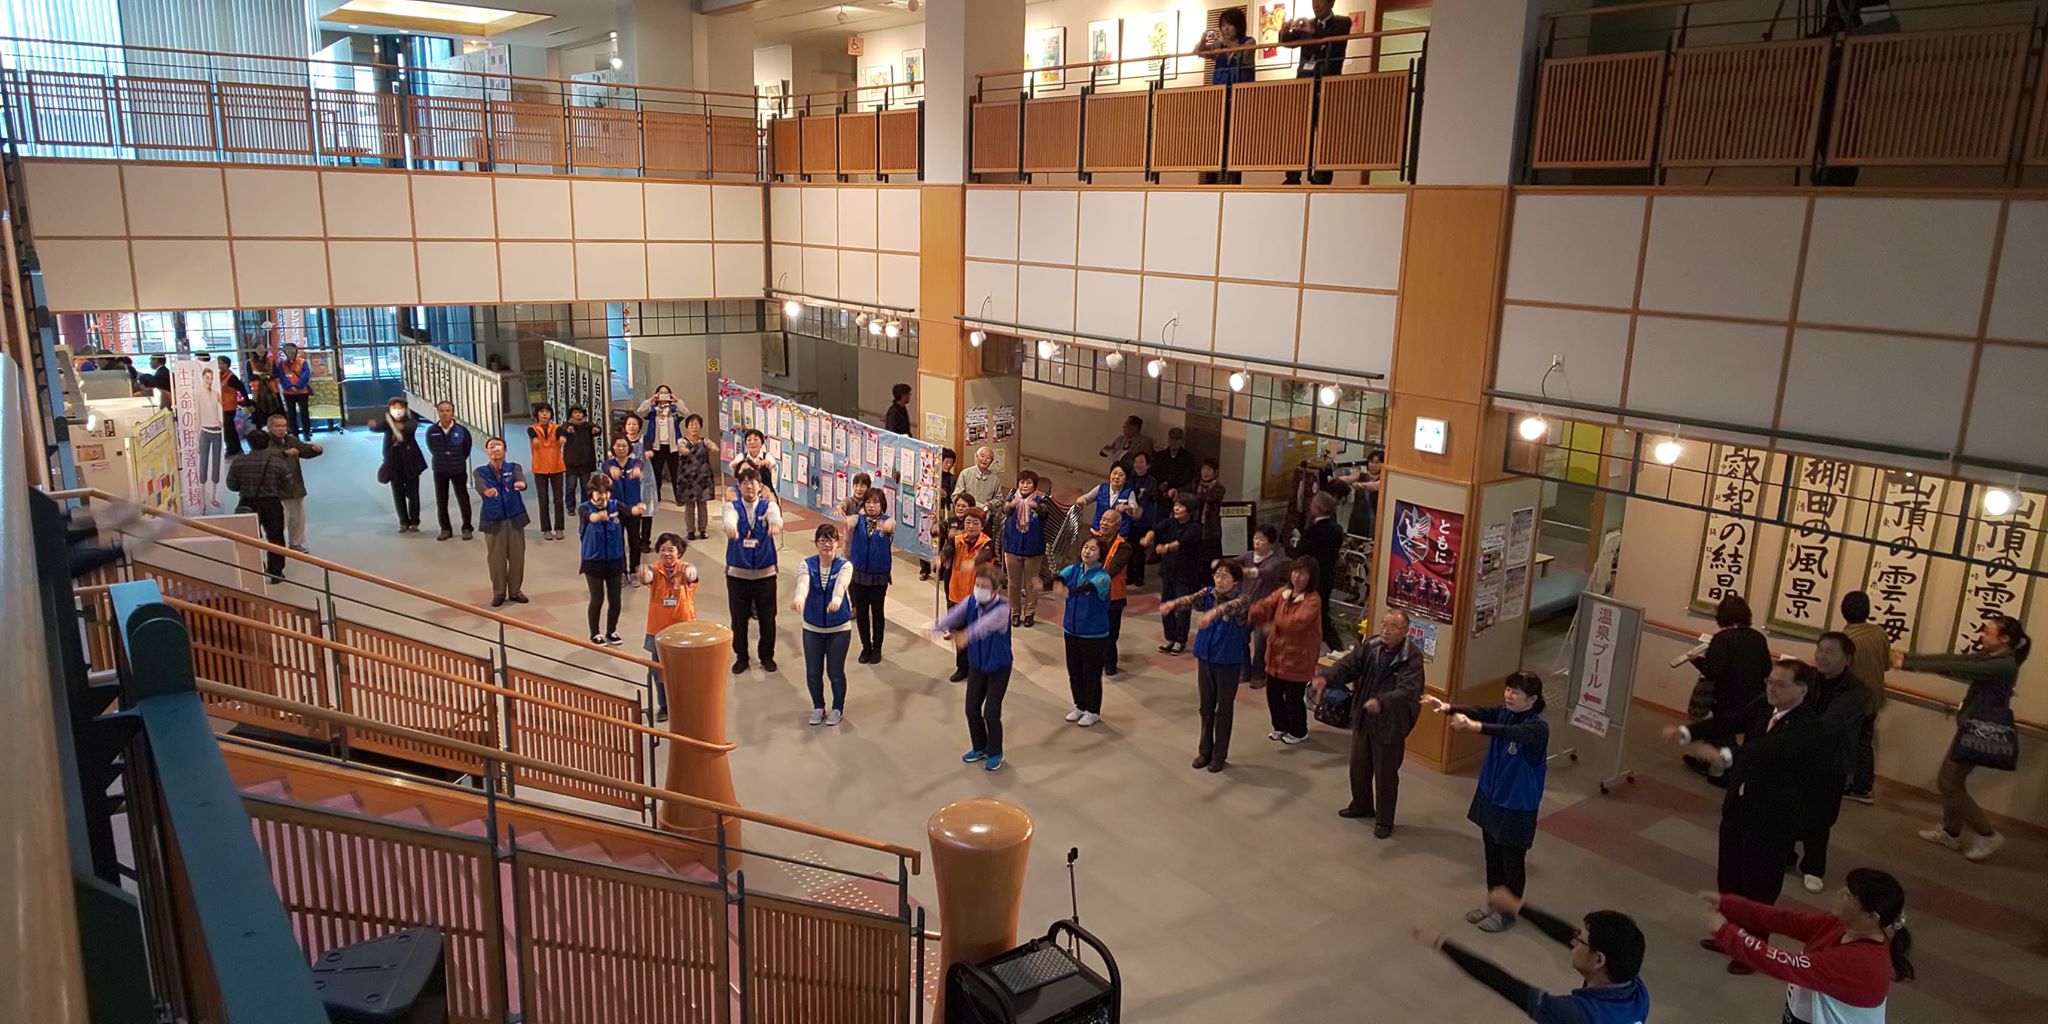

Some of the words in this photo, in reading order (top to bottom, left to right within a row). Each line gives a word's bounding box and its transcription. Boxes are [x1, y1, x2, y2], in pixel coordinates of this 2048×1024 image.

[1435, 519, 1450, 564] ともに
[1708, 447, 1760, 600] 叡智の結晶
[1785, 459, 1849, 619] 棚田の風景
[1587, 607, 1613, 689] 温泉プール
[1766, 946, 1811, 968] SINCE
